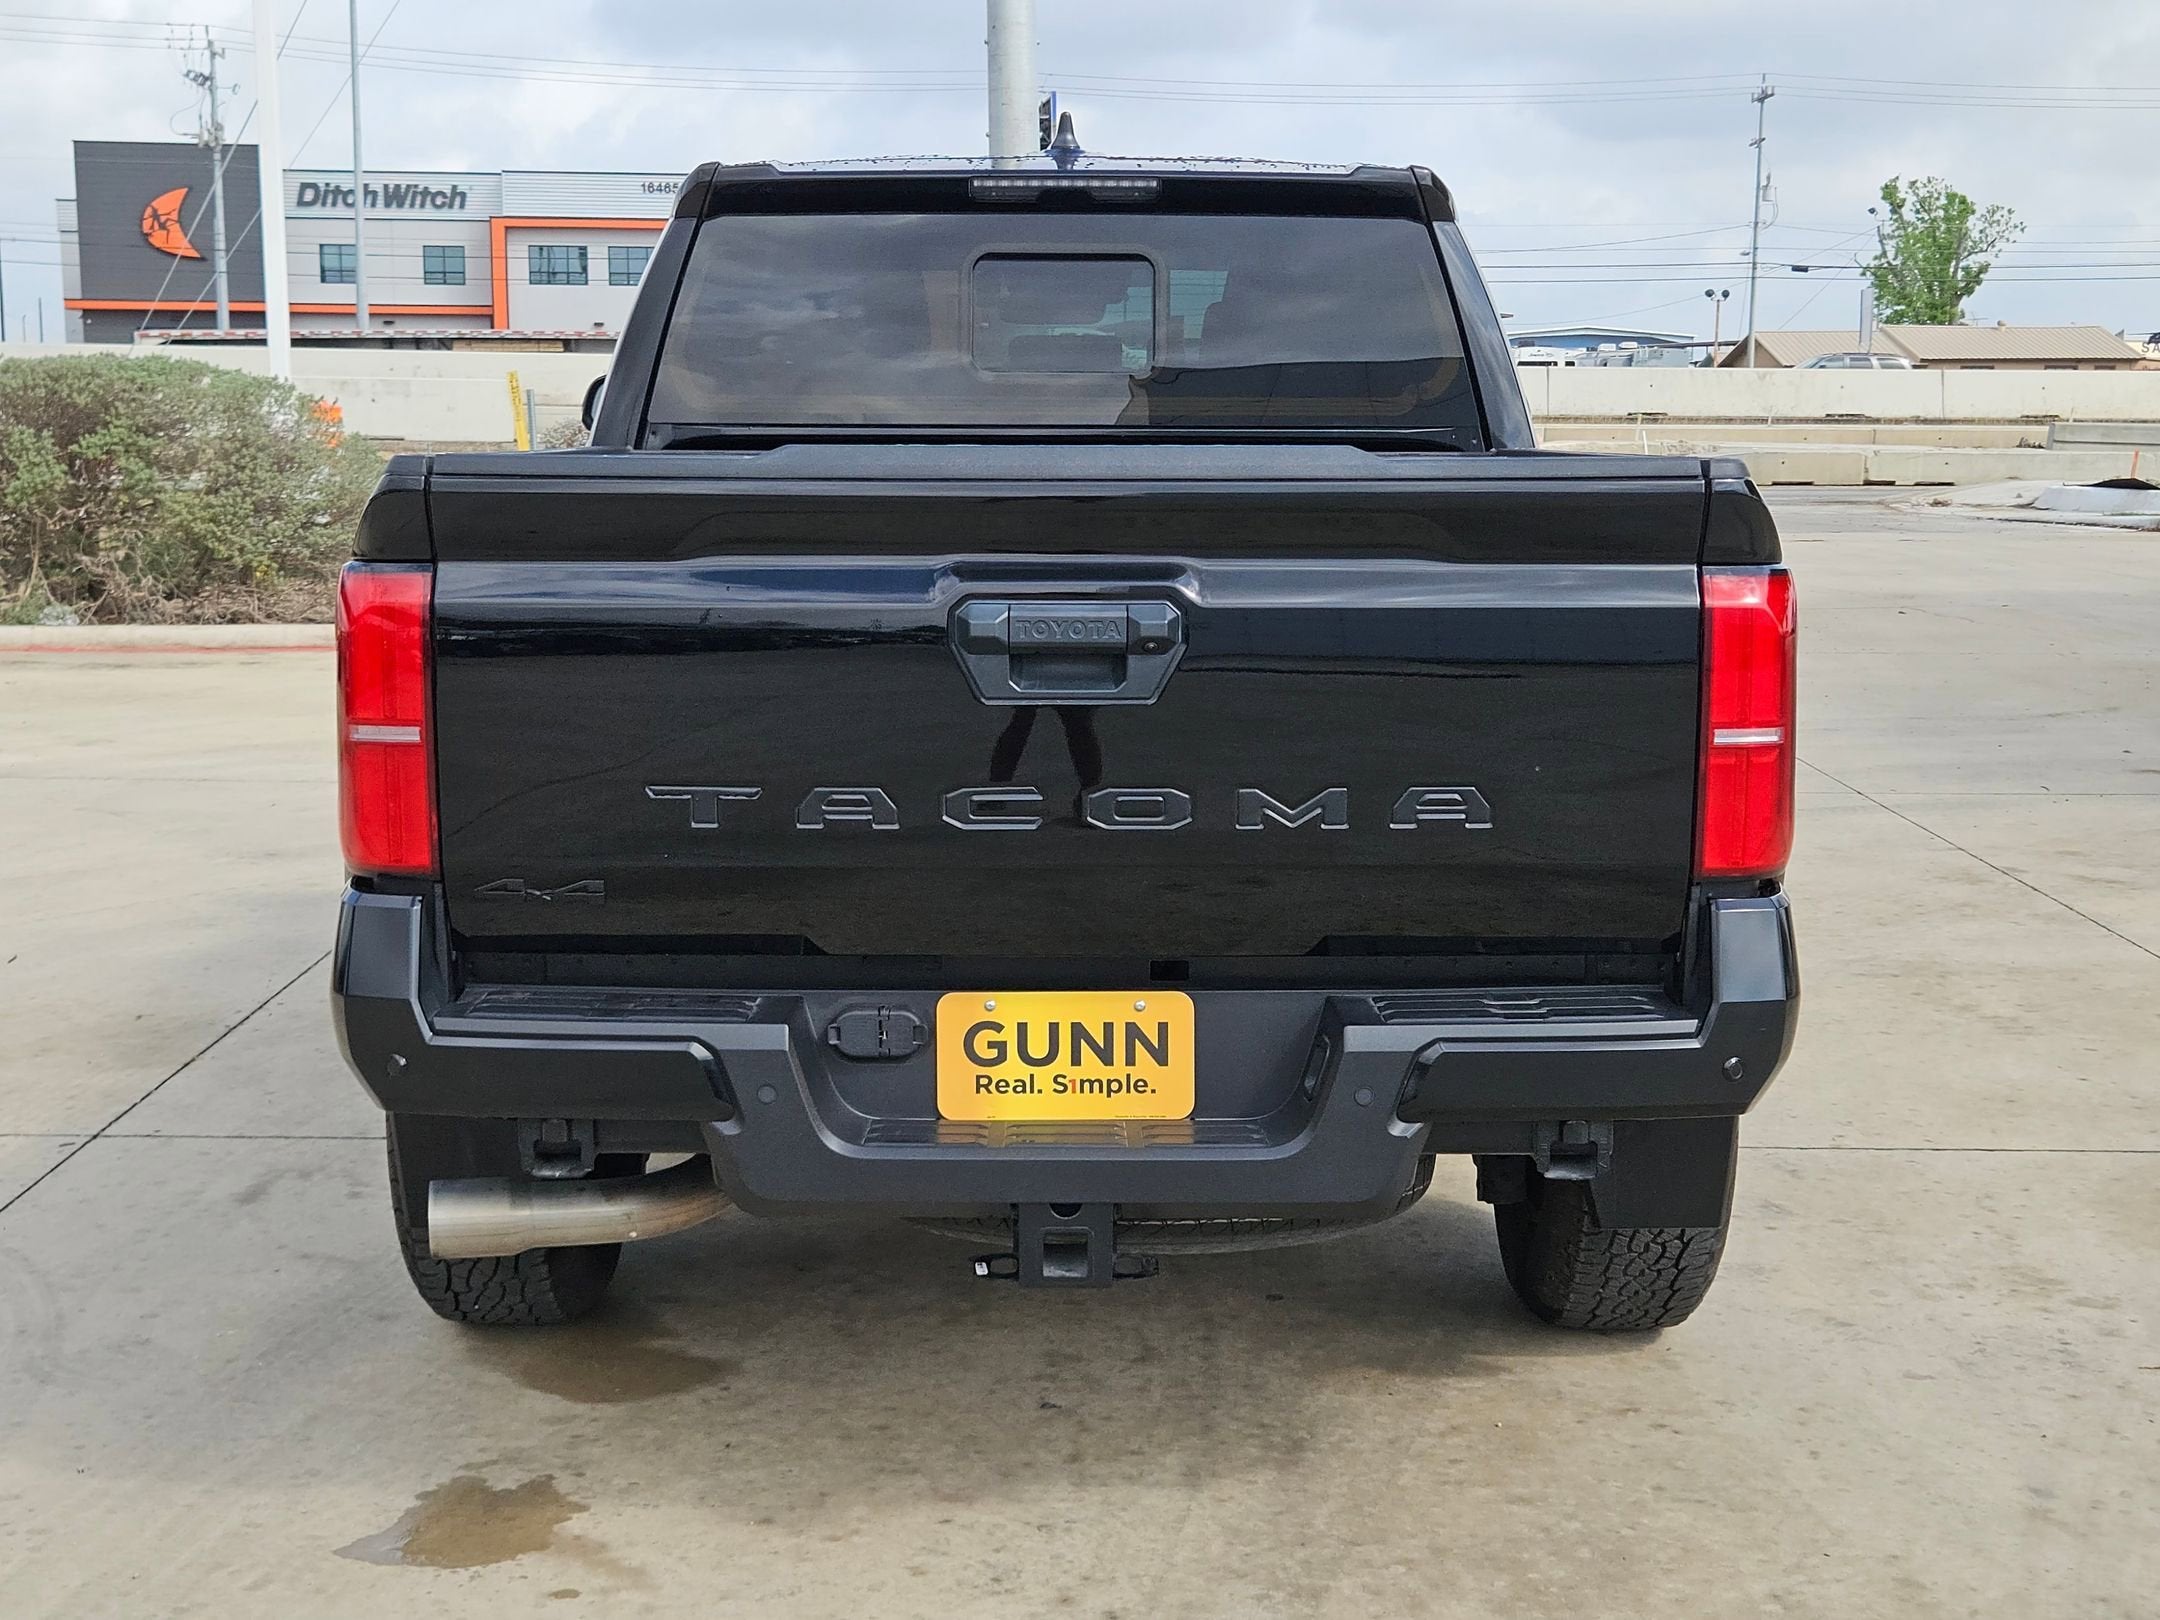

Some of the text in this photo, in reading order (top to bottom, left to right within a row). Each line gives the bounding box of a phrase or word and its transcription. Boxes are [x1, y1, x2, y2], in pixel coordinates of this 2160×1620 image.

[297, 181, 468, 210] Ditch Witch
[1015, 619, 1122, 640] TOYOTA
[645, 785, 1493, 829] TACOMA
[963, 1020, 1169, 1068] GUNN
[975, 1074, 1043, 1095] Real.
